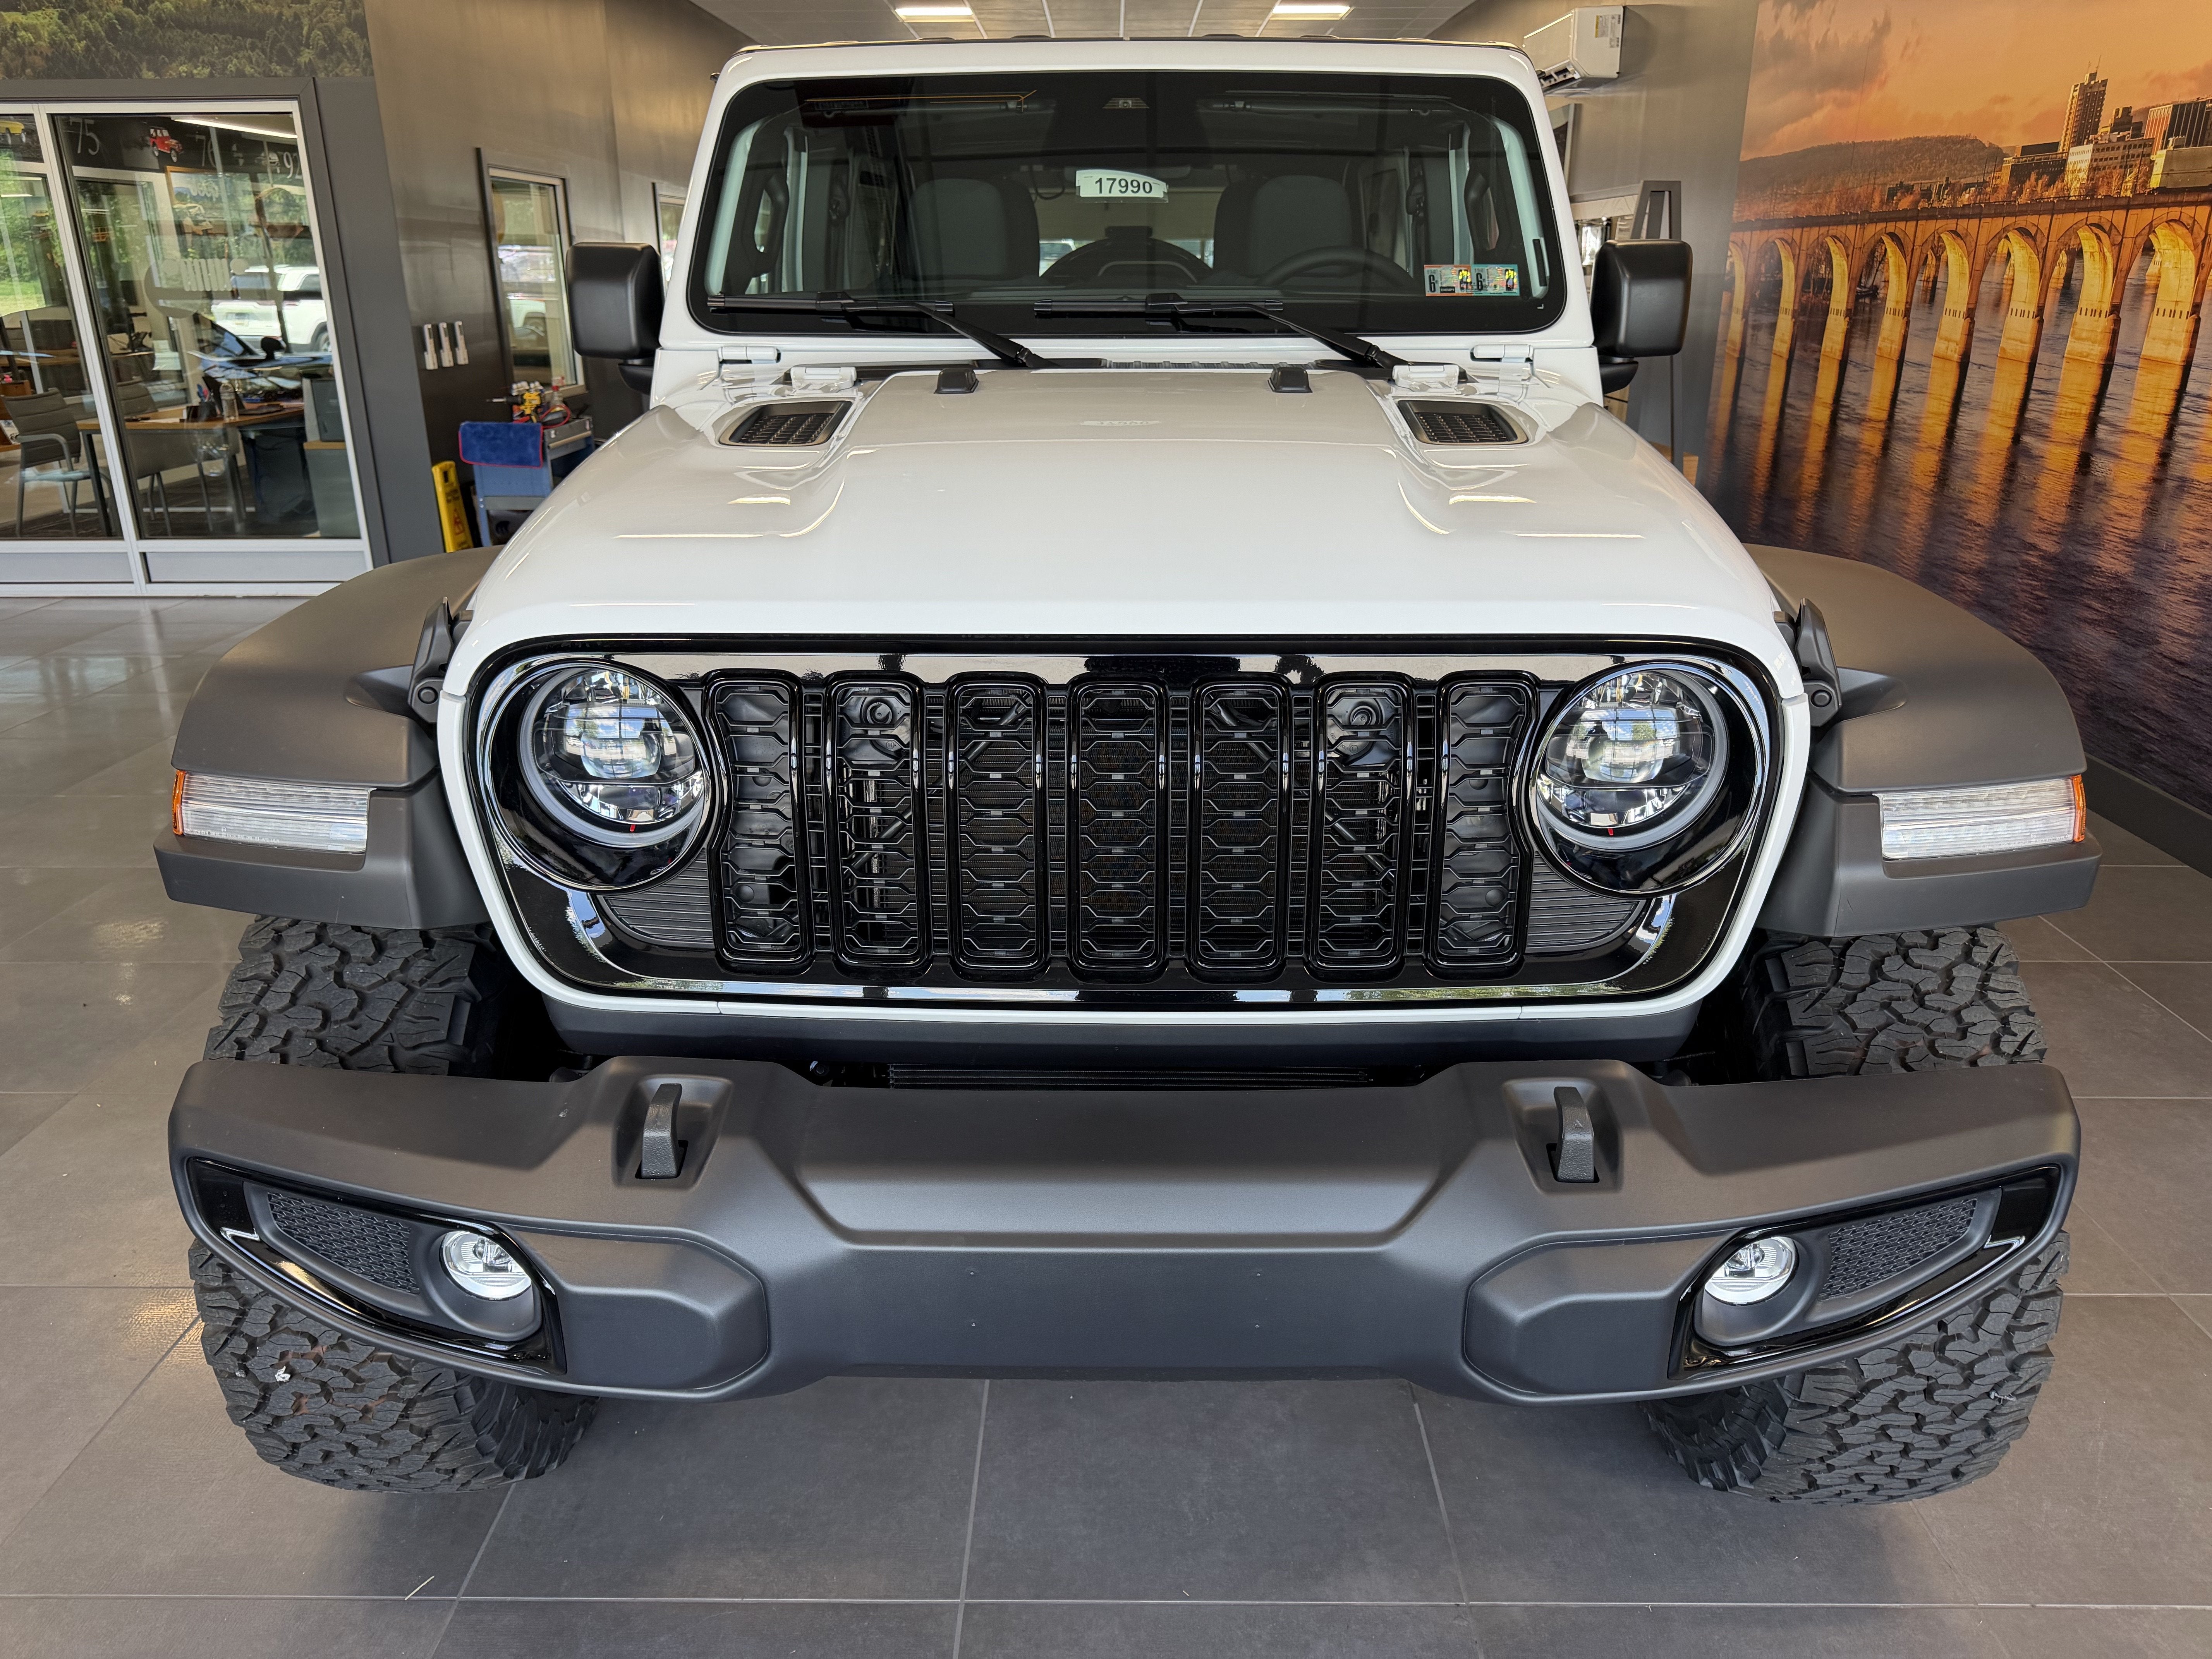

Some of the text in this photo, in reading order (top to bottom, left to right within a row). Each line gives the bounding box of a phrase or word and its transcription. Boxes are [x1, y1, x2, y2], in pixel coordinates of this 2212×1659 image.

[70, 118, 99, 155] 75
[1095, 177, 1152, 194] 17990
[1428, 274, 1436, 293] 6
[1476, 273, 1484, 291] 6
